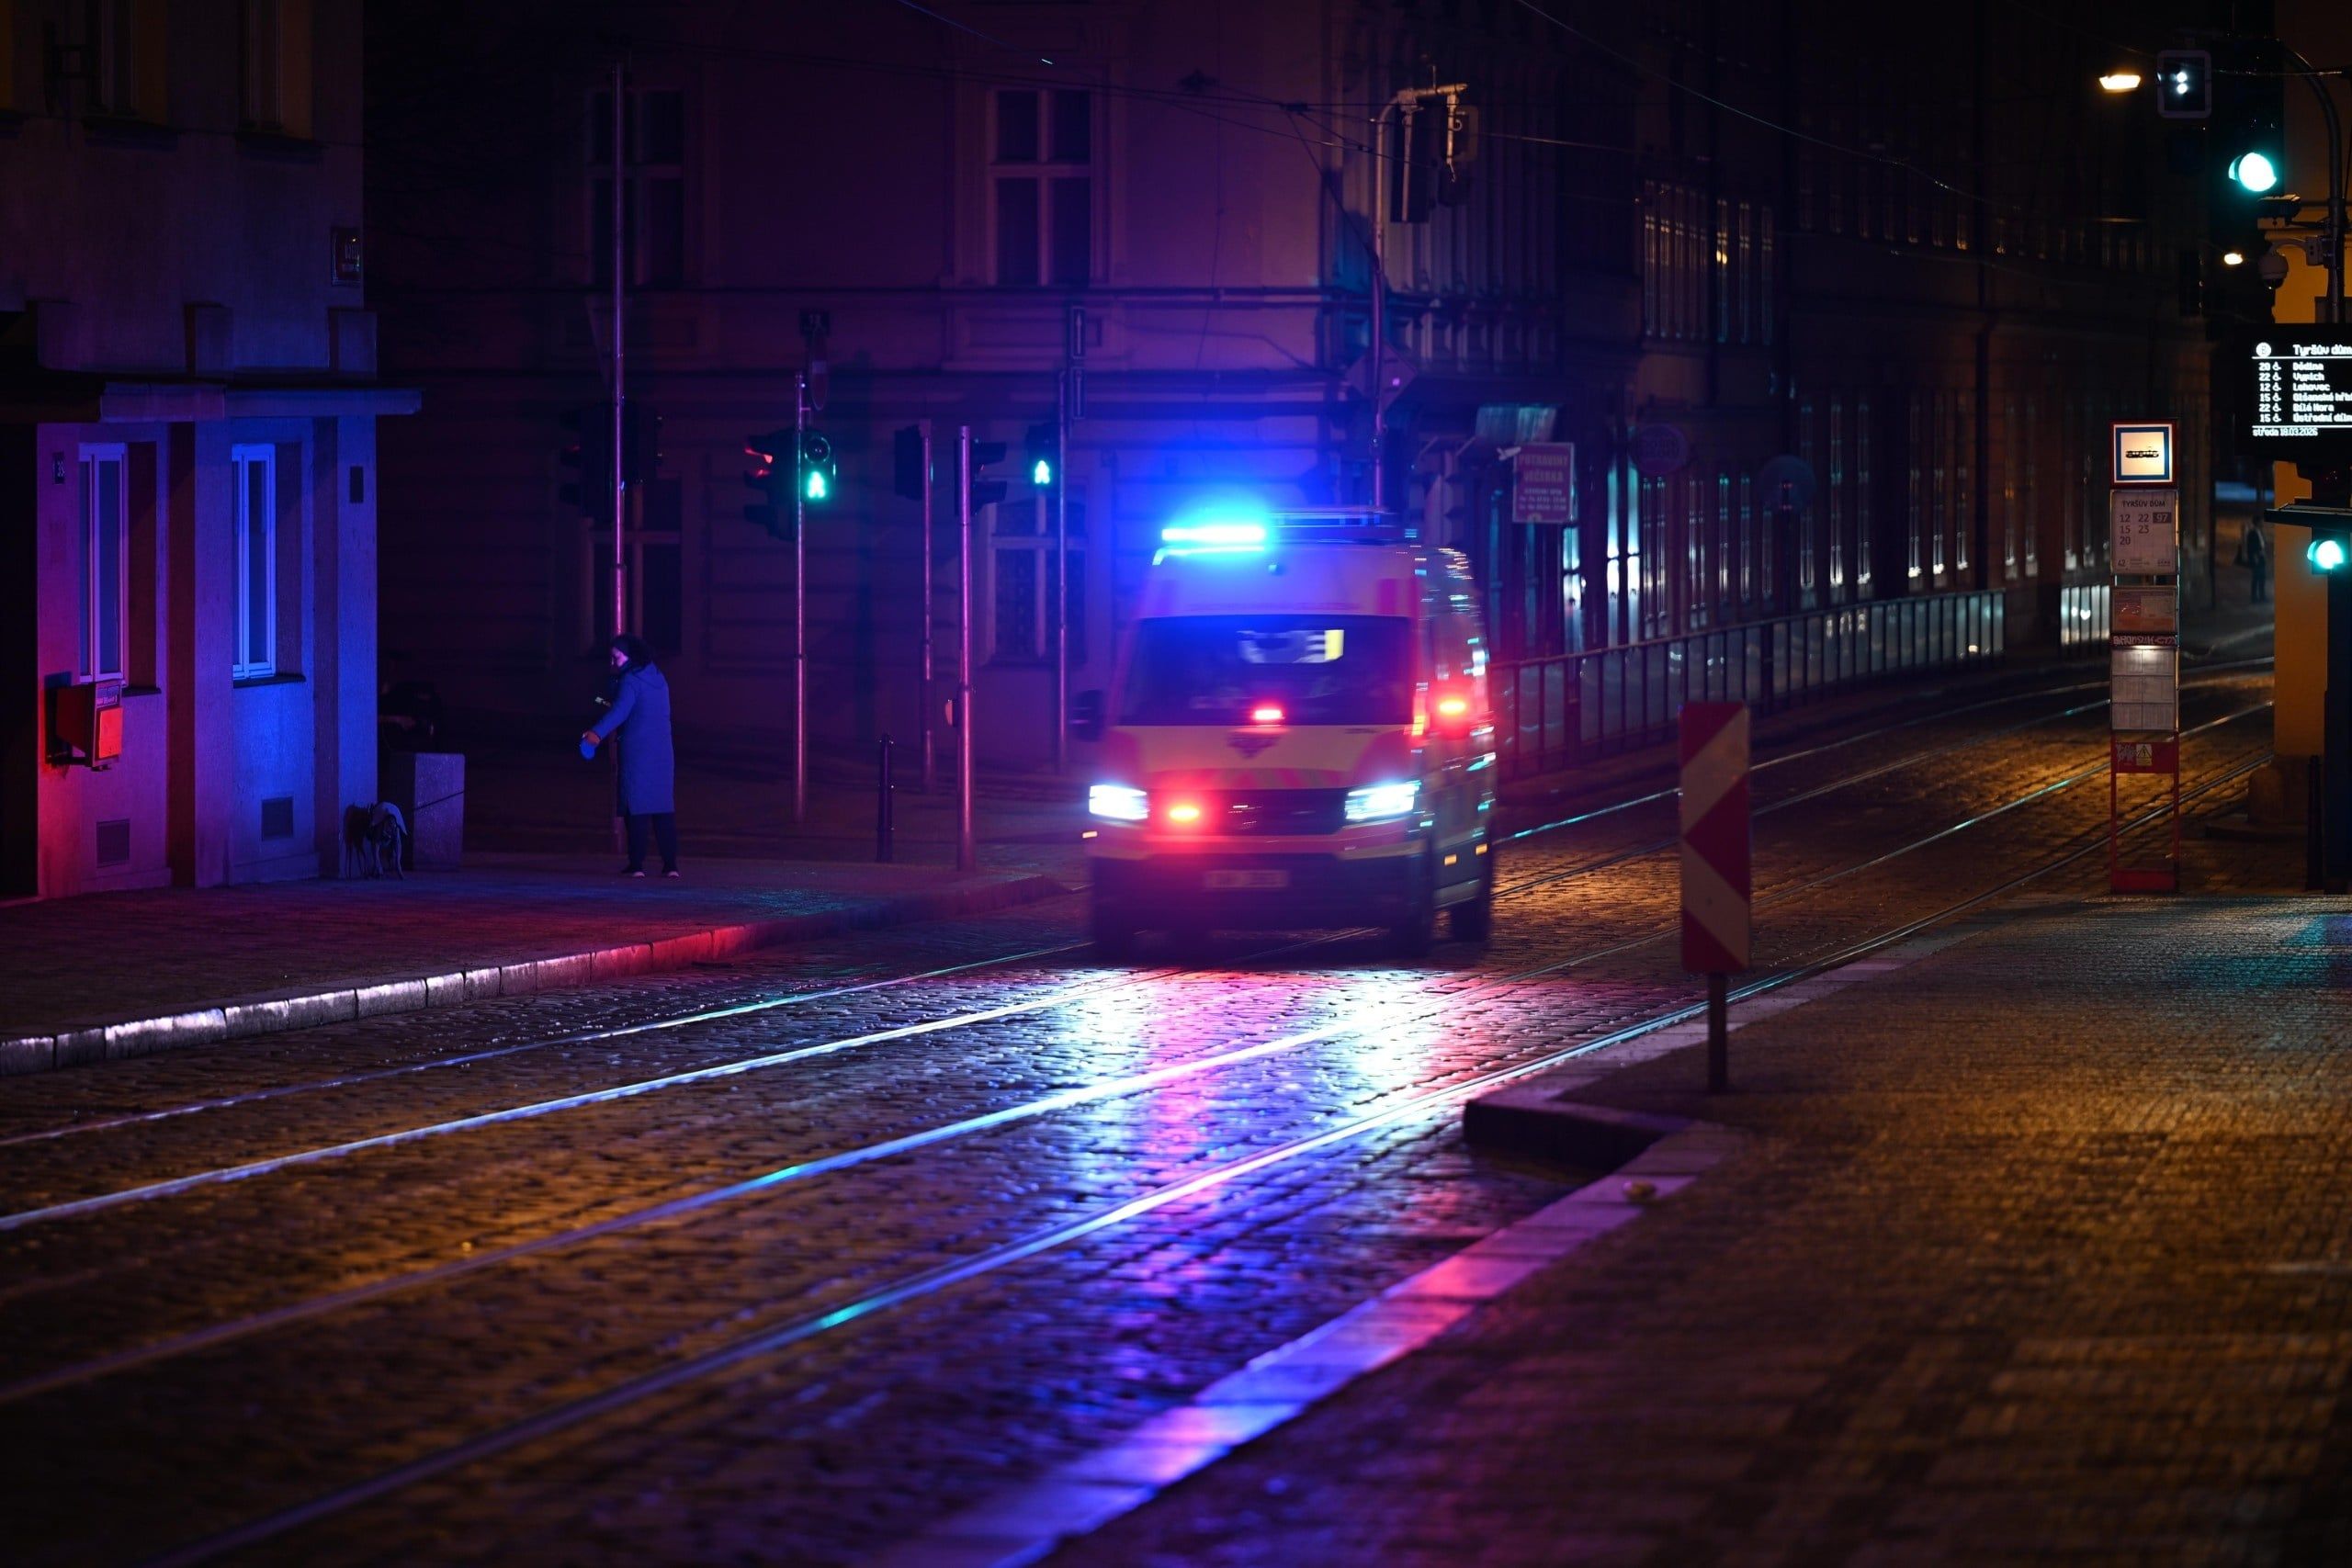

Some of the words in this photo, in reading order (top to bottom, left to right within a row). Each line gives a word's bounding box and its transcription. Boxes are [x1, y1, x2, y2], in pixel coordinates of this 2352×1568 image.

[2293, 344, 2329, 356] Tyršův
[2259, 373, 2270, 381] 22
[2260, 383, 2270, 391] 12
[2260, 393, 2270, 401] 15
[2260, 414, 2270, 423] 15
[2122, 499, 2148, 507] TYRŠŮV
[2150, 499, 2165, 507] DŮM
[2120, 513, 2131, 523] 12
[2138, 513, 2149, 523] 22
[2156, 513, 2168, 522] 97
[2120, 525, 2131, 534] 15
[2138, 525, 2150, 534] 23
[2120, 536, 2131, 546] 20
